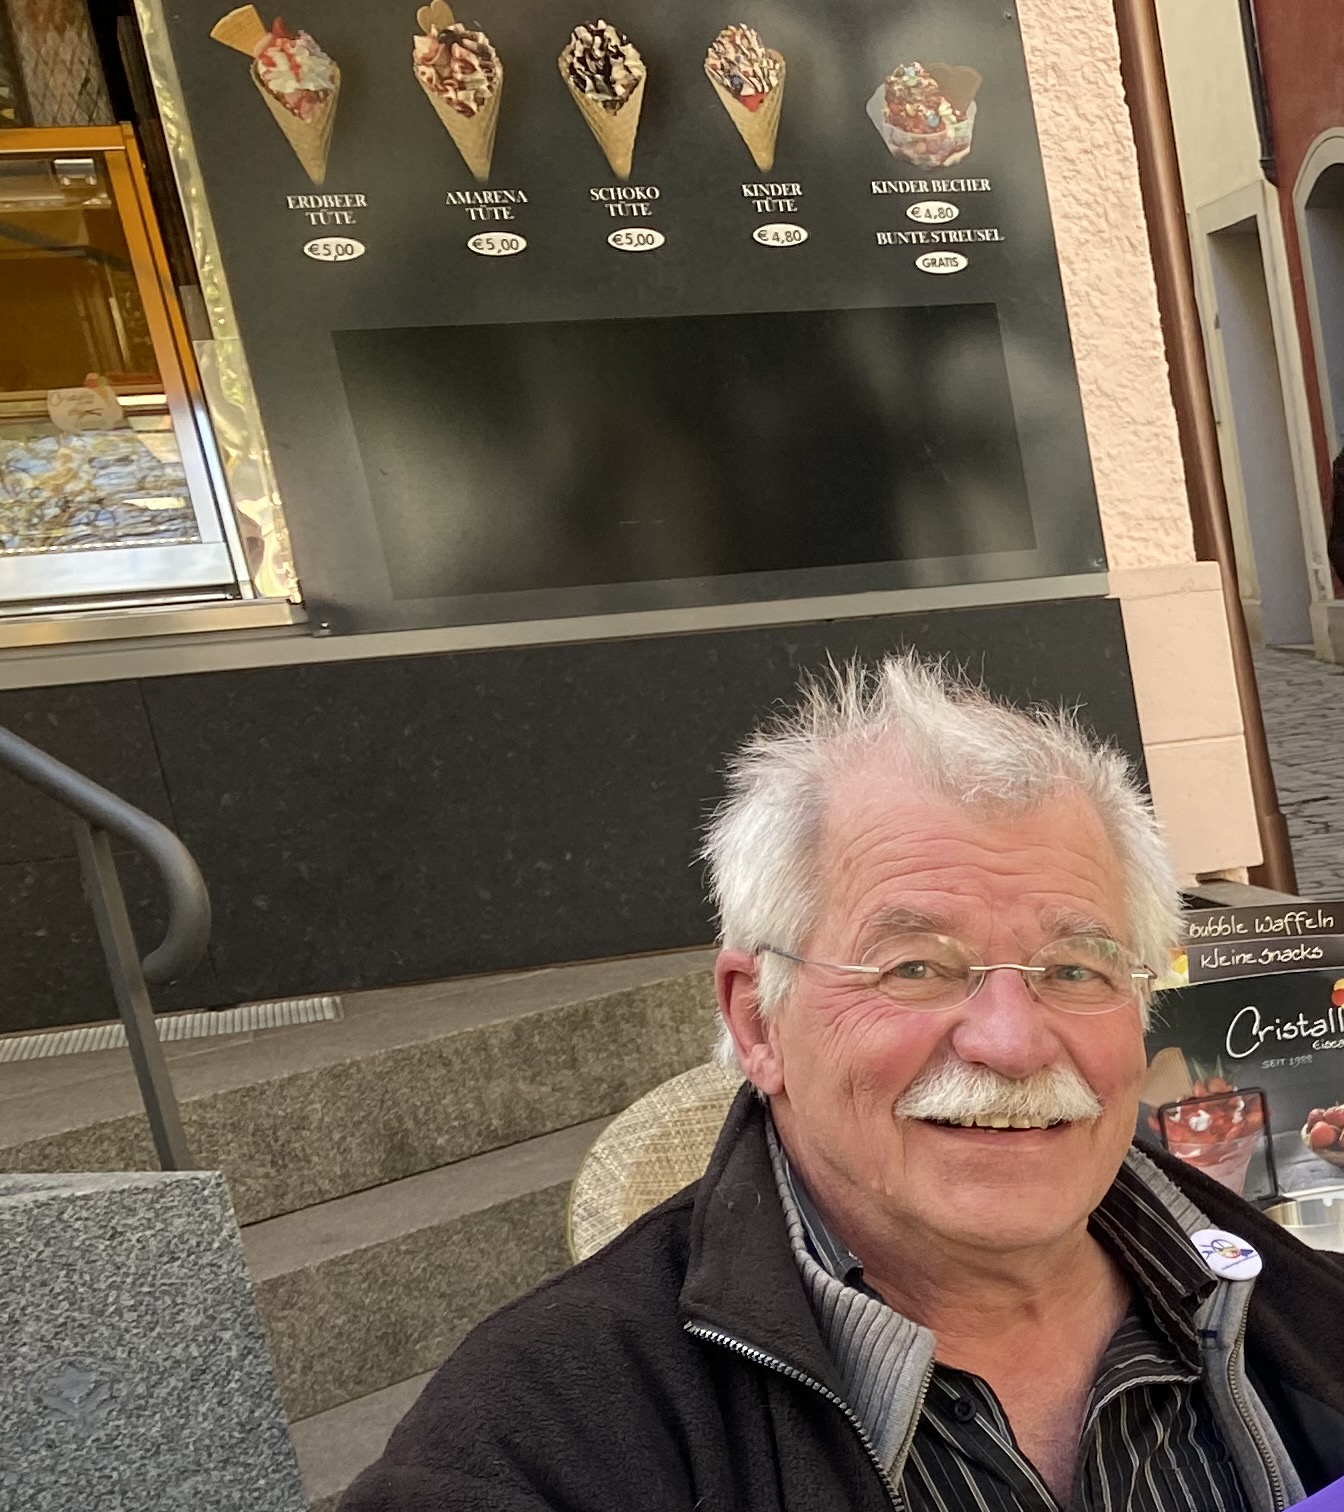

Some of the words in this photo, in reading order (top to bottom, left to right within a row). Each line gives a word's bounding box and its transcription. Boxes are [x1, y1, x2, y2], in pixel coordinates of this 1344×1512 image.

[590, 186, 660, 201] SCHOKO
[741, 182, 803, 197] KINDER
[871, 179, 930, 195] KINDER
[932, 178, 992, 193] BECHER
[286, 194, 368, 210] ERDBEER
[445, 190, 528, 205] AMARENA
[752, 197, 798, 213] TÜTE
[465, 205, 516, 222] TÜTE
[604, 200, 653, 217] TÜTE
[304, 208, 357, 226] TÜTE
[876, 230, 930, 246] BUNTE
[930, 228, 1005, 244] STREUSEL
[922, 256, 959, 269] GRATIS
[1254, 908, 1335, 936] Waffeln
[1261, 1058, 1286, 1069] SEIT
